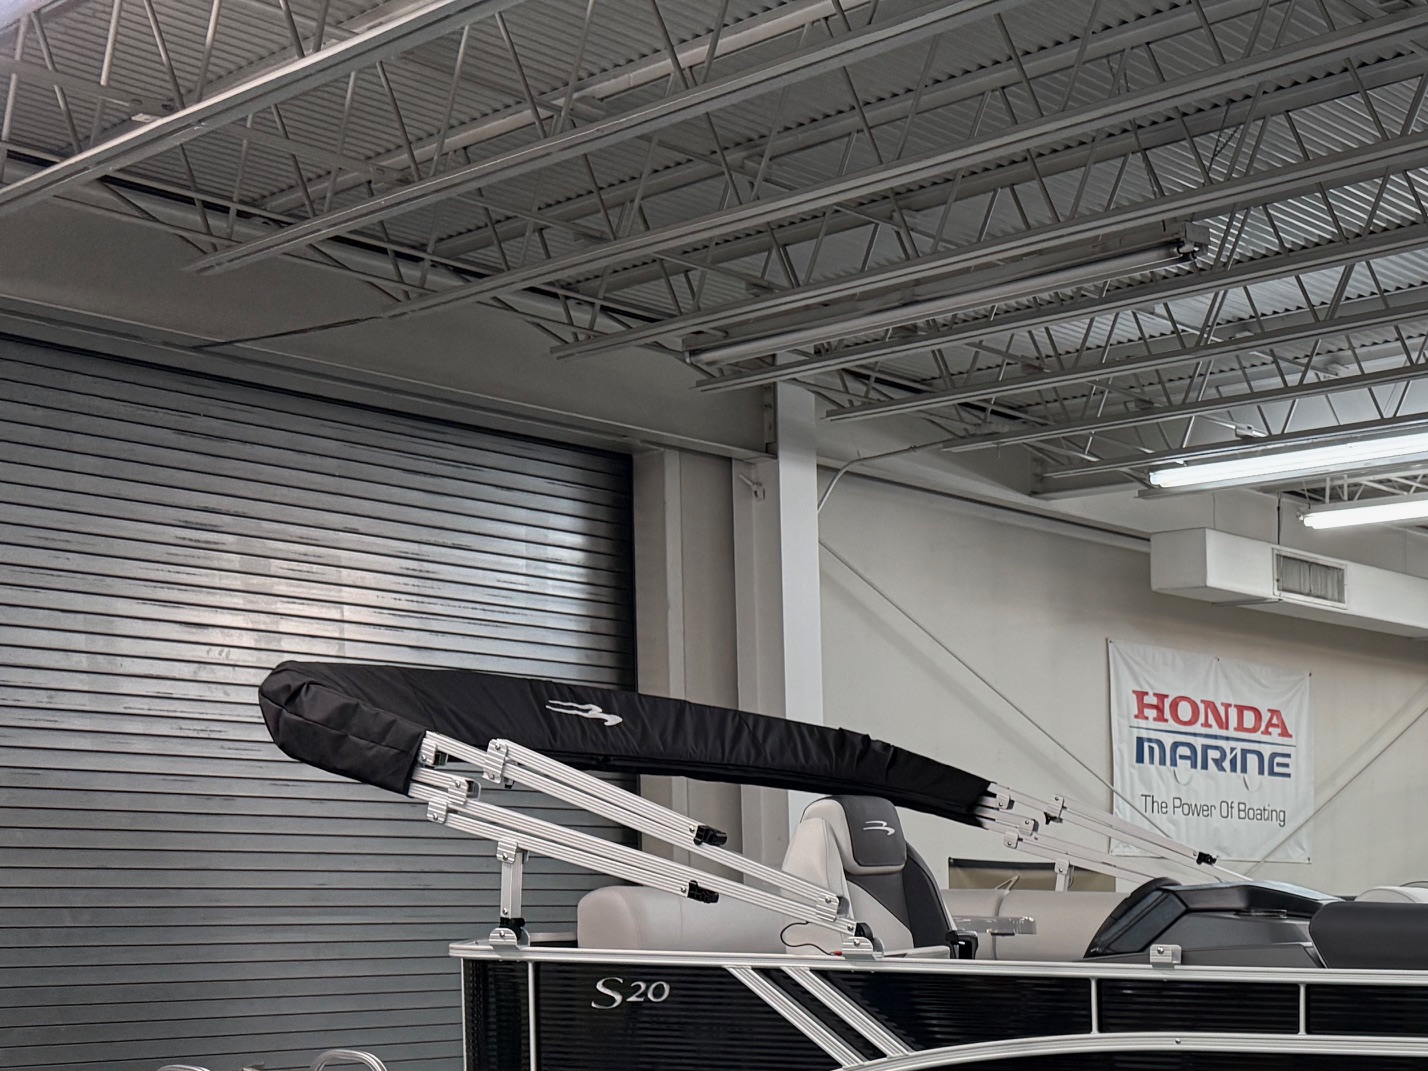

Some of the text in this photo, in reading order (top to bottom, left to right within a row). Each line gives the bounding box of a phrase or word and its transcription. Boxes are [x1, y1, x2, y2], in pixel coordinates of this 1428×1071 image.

[1132, 689, 1293, 738] HONDA
[1135, 736, 1292, 778] MARINE
[1140, 793, 1287, 828] The Power Of Boating
[590, 976, 671, 1010] S20
